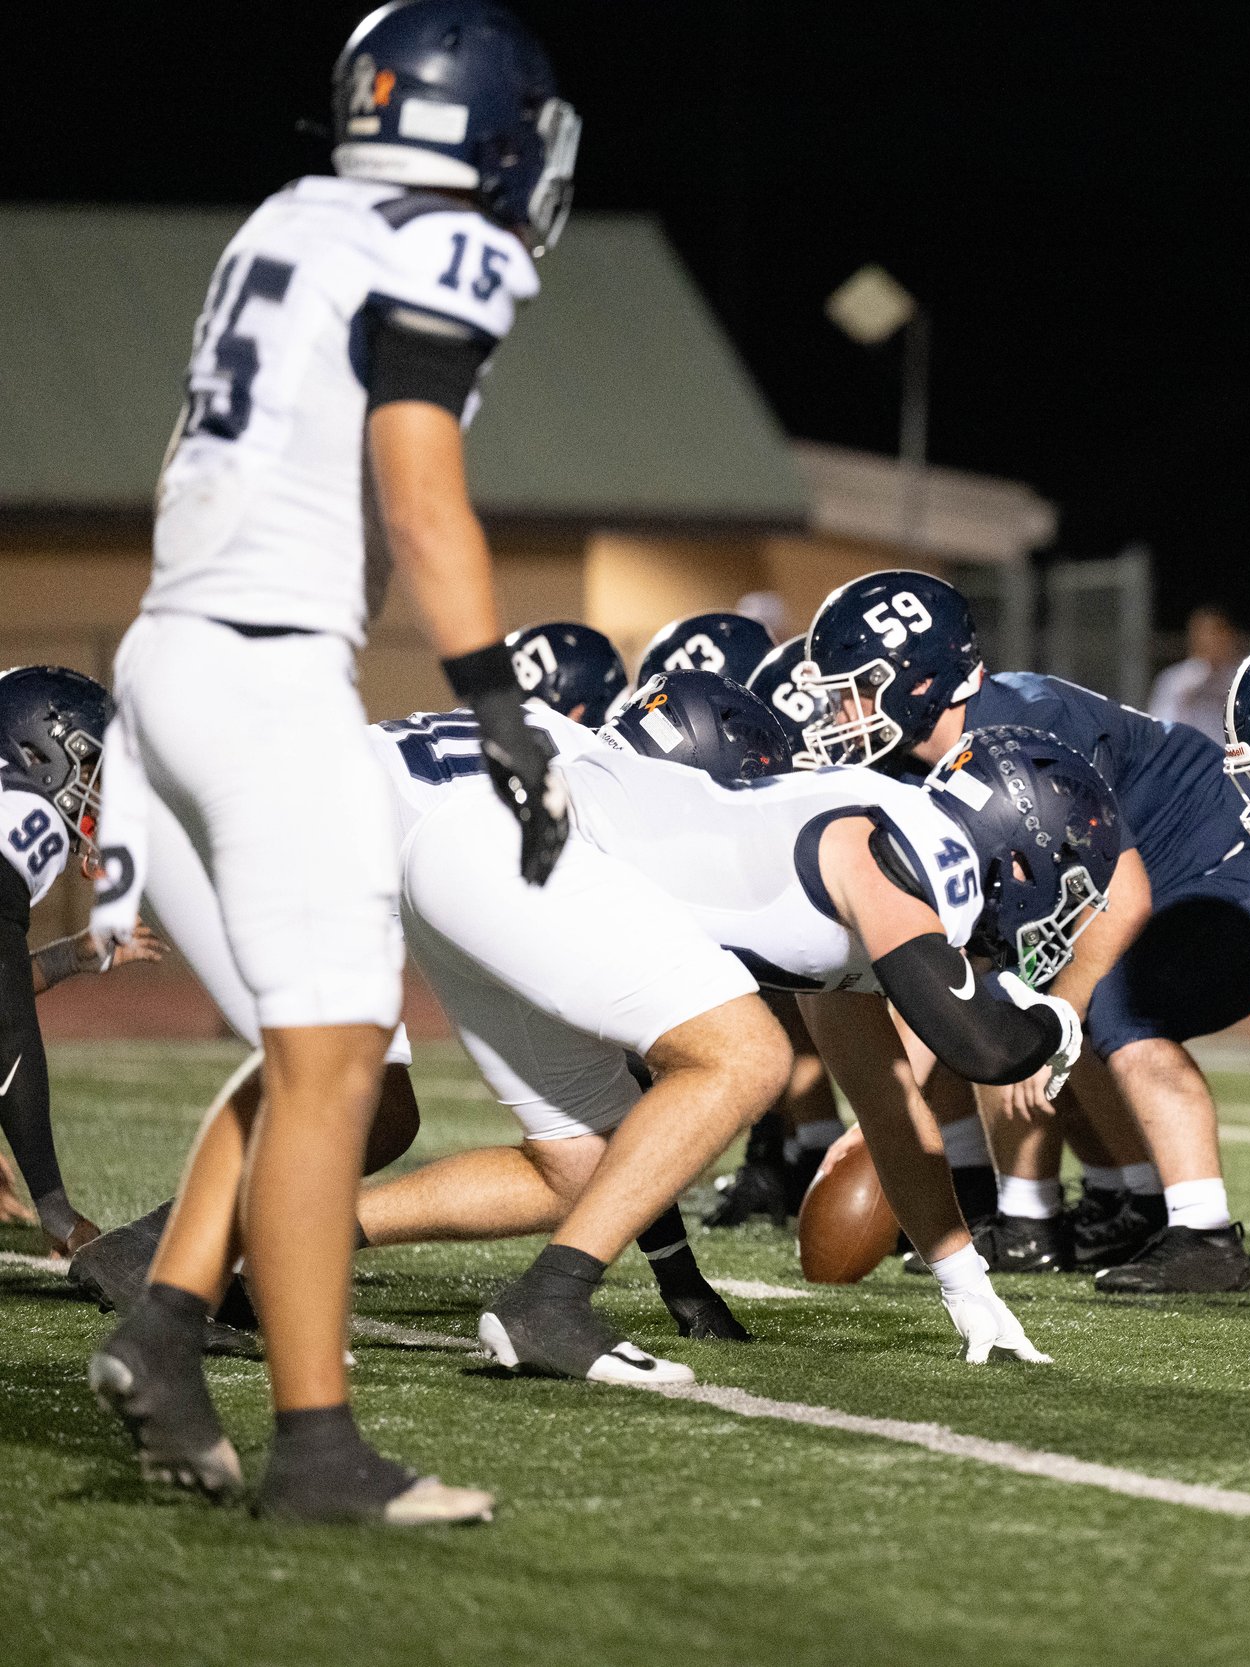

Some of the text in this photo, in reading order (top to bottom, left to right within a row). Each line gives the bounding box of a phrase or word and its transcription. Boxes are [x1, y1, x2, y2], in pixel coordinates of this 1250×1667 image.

[438, 232, 508, 301] 15
[862, 591, 932, 648] 59
[511, 634, 558, 691] 87
[664, 634, 726, 674] 73
[8, 808, 64, 876] 99
[934, 836, 978, 909] 45
